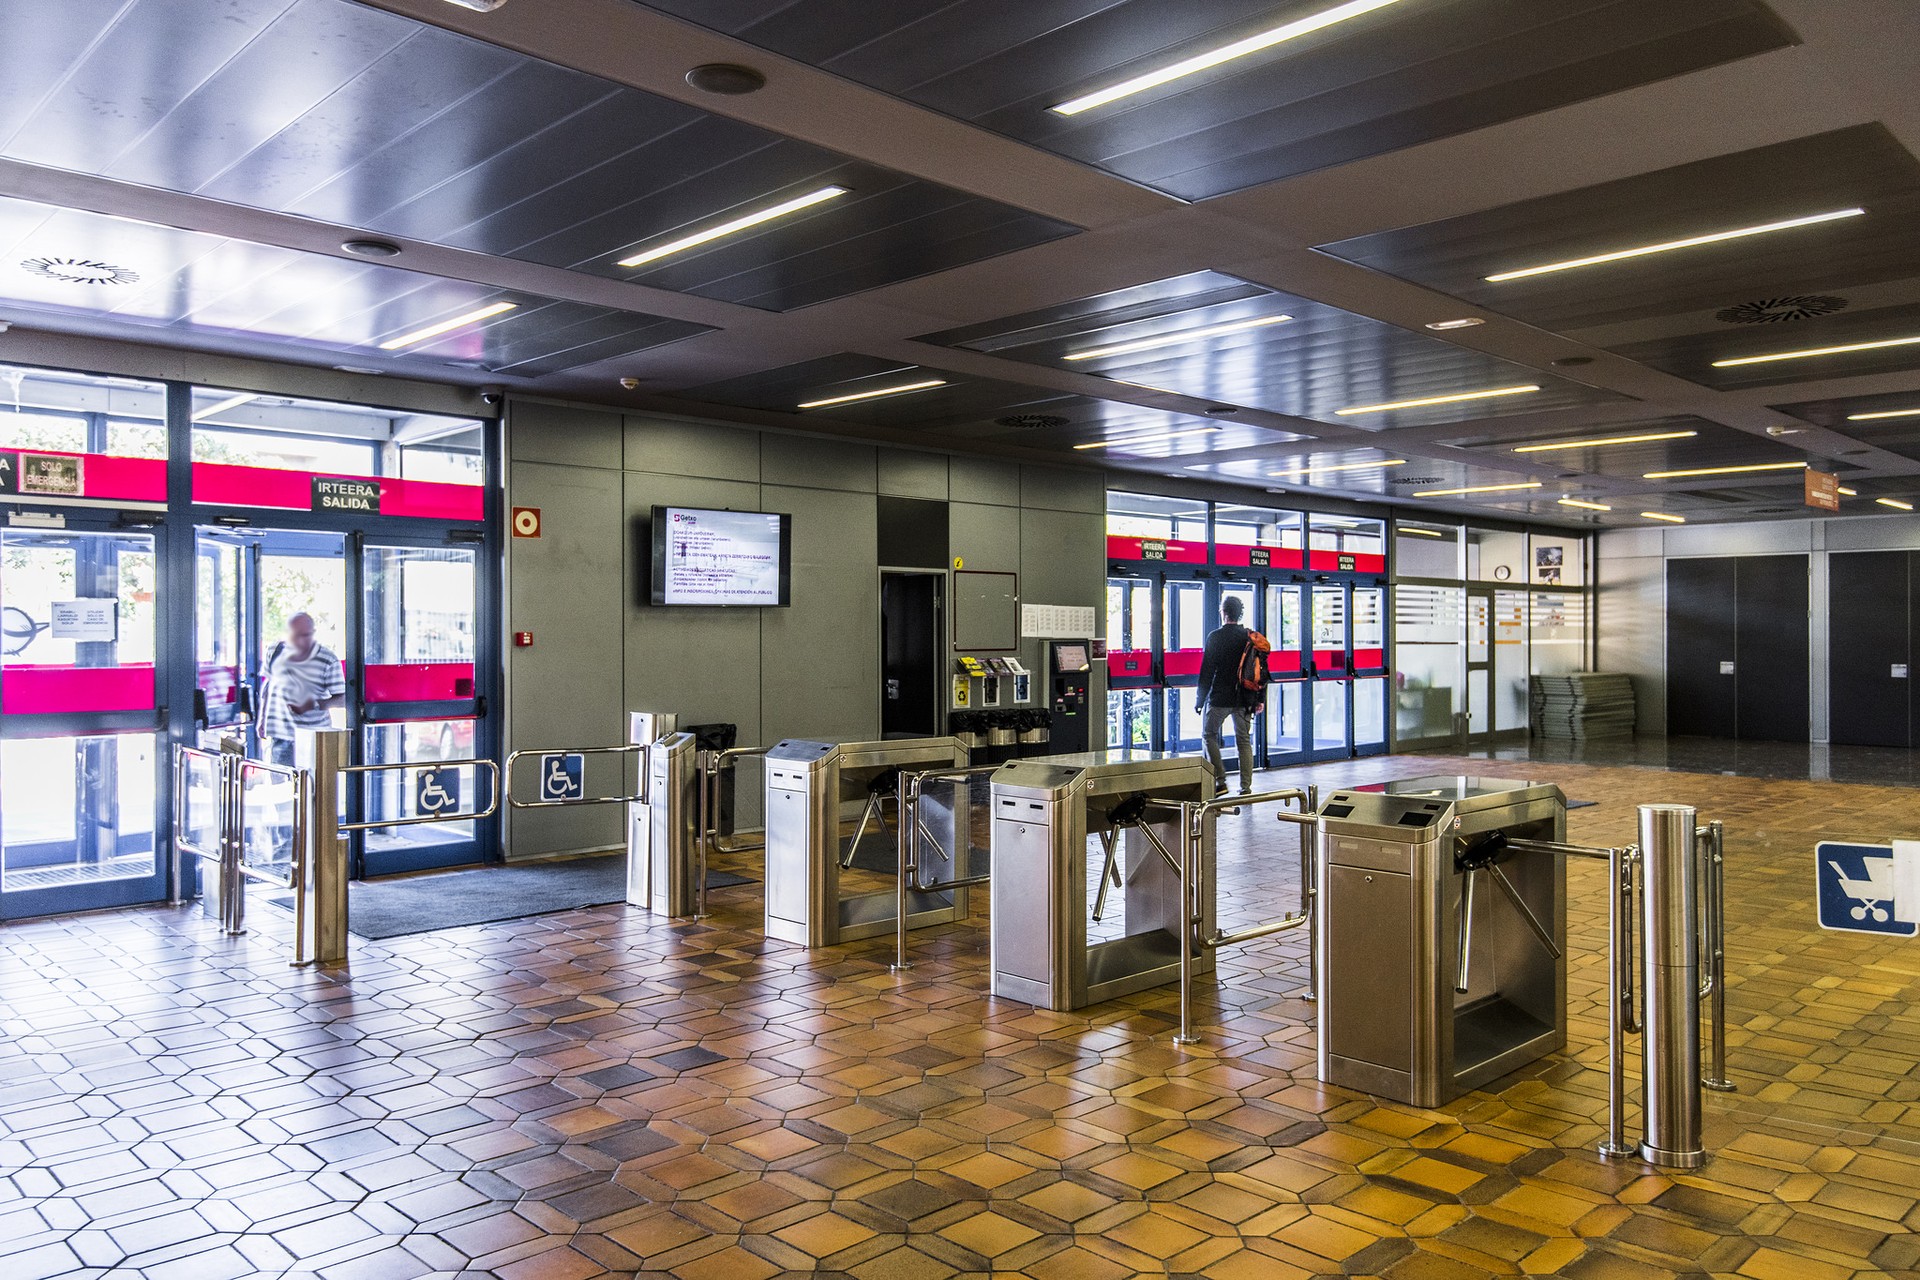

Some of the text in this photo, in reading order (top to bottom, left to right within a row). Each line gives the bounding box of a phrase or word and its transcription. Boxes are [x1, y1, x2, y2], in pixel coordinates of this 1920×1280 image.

[40, 460, 63, 472] SOLO
[26, 474, 77, 487] EMERGENCIA
[318, 482, 375, 497] IRTEERA
[322, 496, 370, 510] SALIDA
[680, 514, 697, 522] Getxo
[1143, 542, 1165, 551] IRTEERA
[1145, 550, 1164, 559] SALIDA
[1251, 550, 1270, 558] IRTEERA
[1252, 558, 1268, 566] SALIDA
